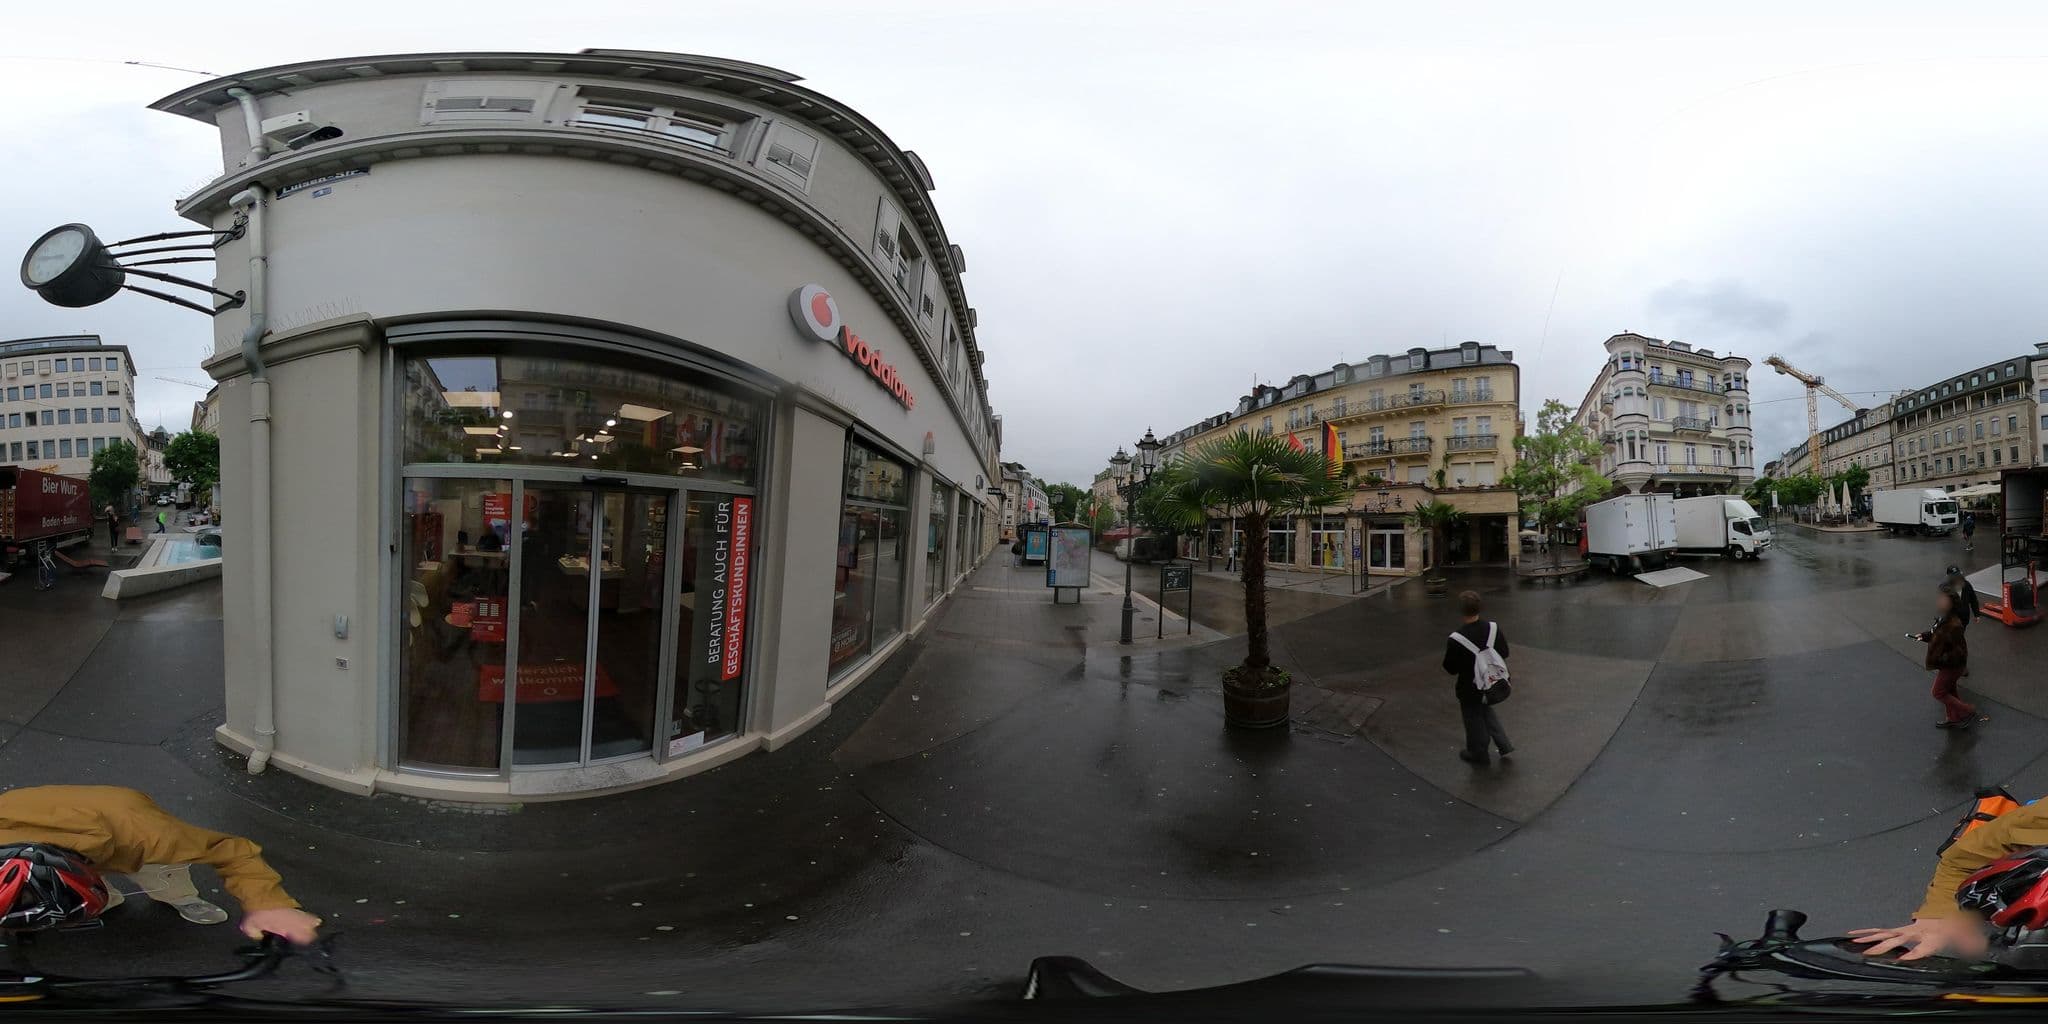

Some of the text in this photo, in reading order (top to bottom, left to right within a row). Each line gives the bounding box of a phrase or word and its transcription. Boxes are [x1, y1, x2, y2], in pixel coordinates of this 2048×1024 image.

[842, 324, 915, 411] vodafone
[42, 476, 78, 496] Bier Wurz
[708, 502, 730, 664] BERATUNG AUCH FÜR
[727, 504, 749, 675] GESCHÄFTSKUND:INNEN
